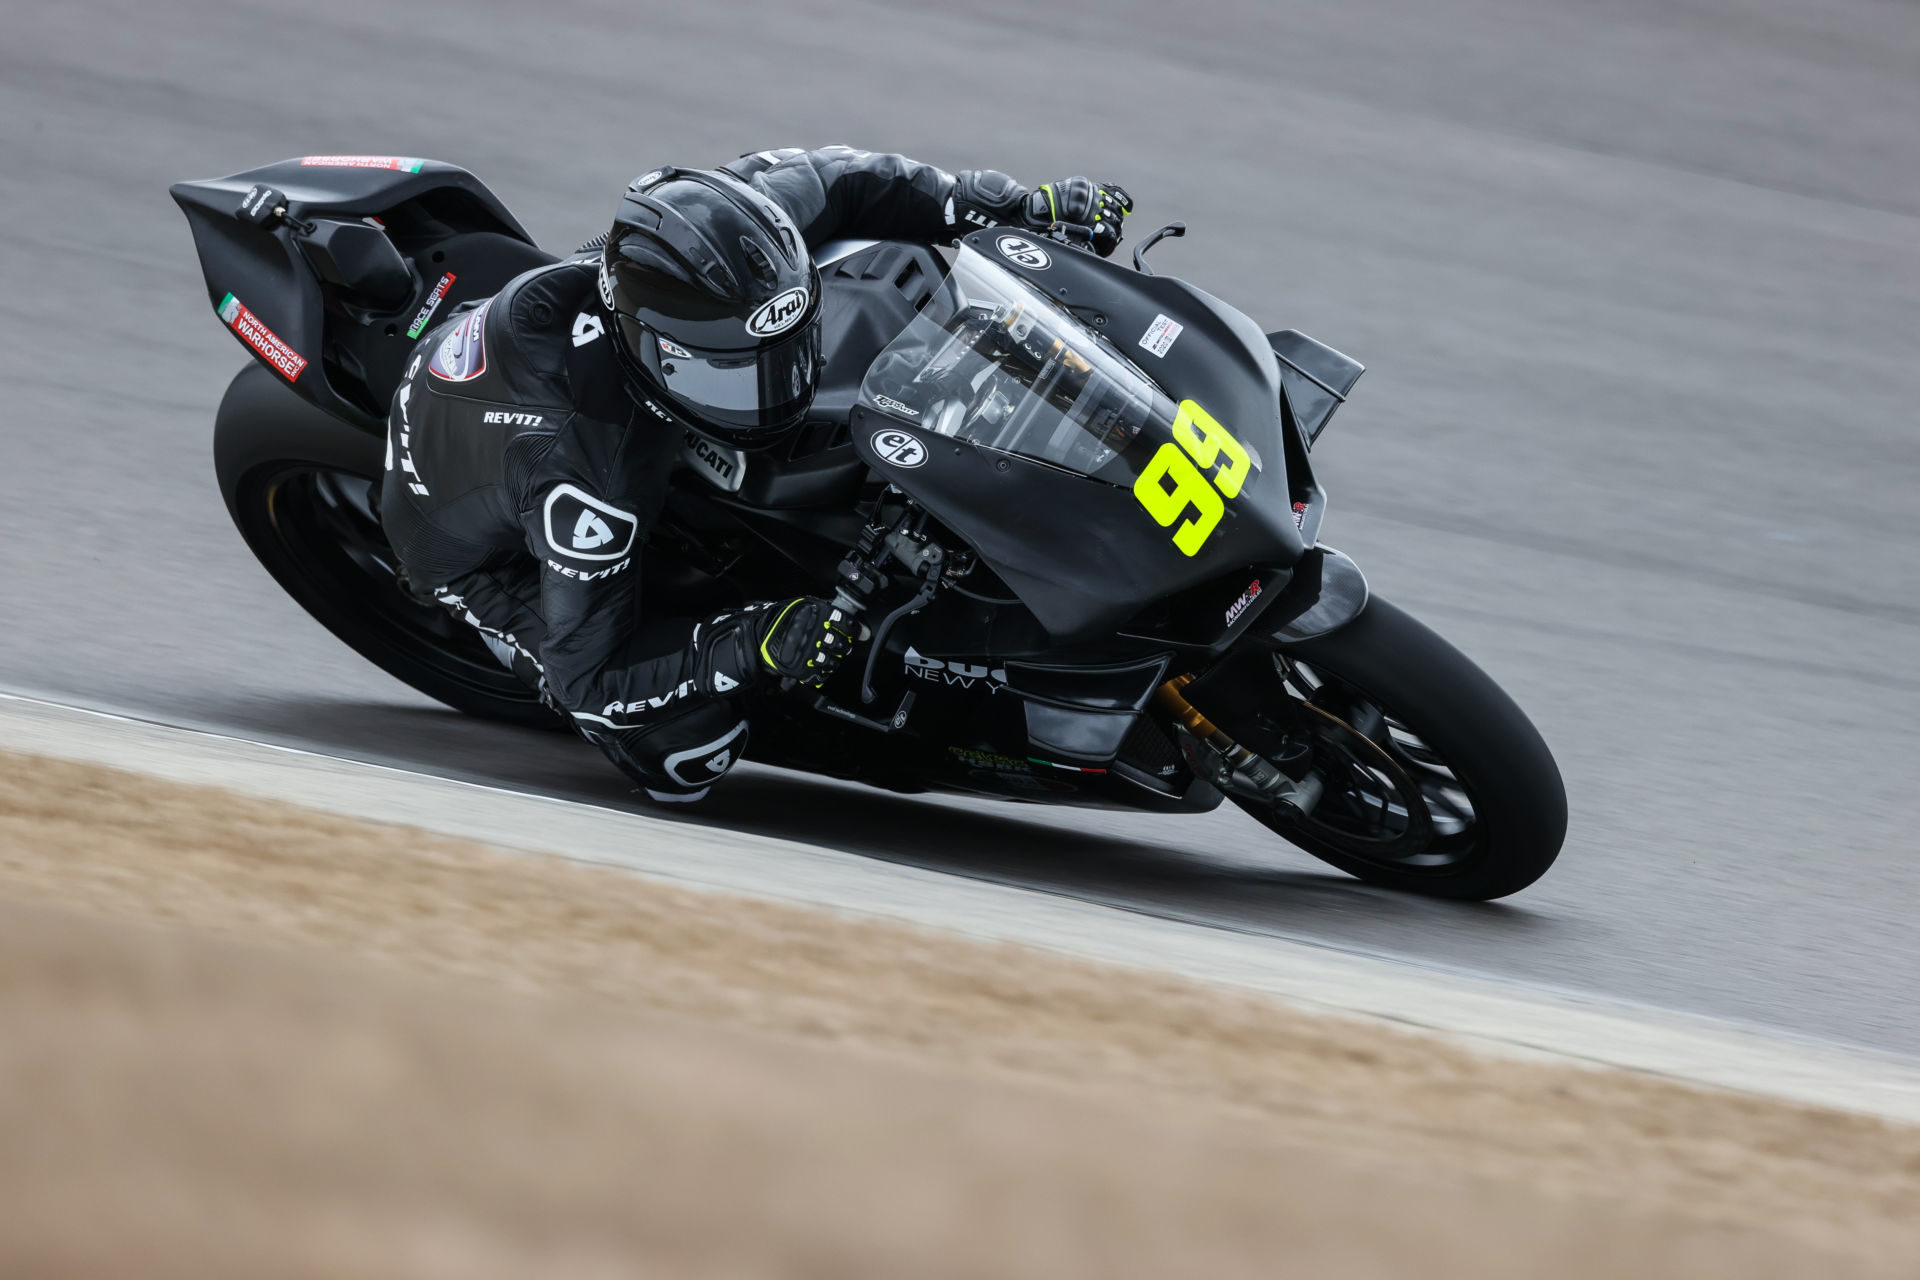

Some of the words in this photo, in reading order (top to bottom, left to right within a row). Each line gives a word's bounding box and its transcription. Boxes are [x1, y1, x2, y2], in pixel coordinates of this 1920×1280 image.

[425, 275, 450, 306] SEATS
[756, 290, 801, 332] Arai
[237, 317, 296, 375] WARHORSE
[243, 311, 267, 336] NORTH
[265, 333, 305, 368] AMERICAN
[483, 411, 543, 428] REV'IT!
[684, 432, 733, 479] UCATI
[1133, 399, 1251, 557] 99
[546, 557, 632, 581] REV'IT!
[904, 664, 976, 690] NEW
